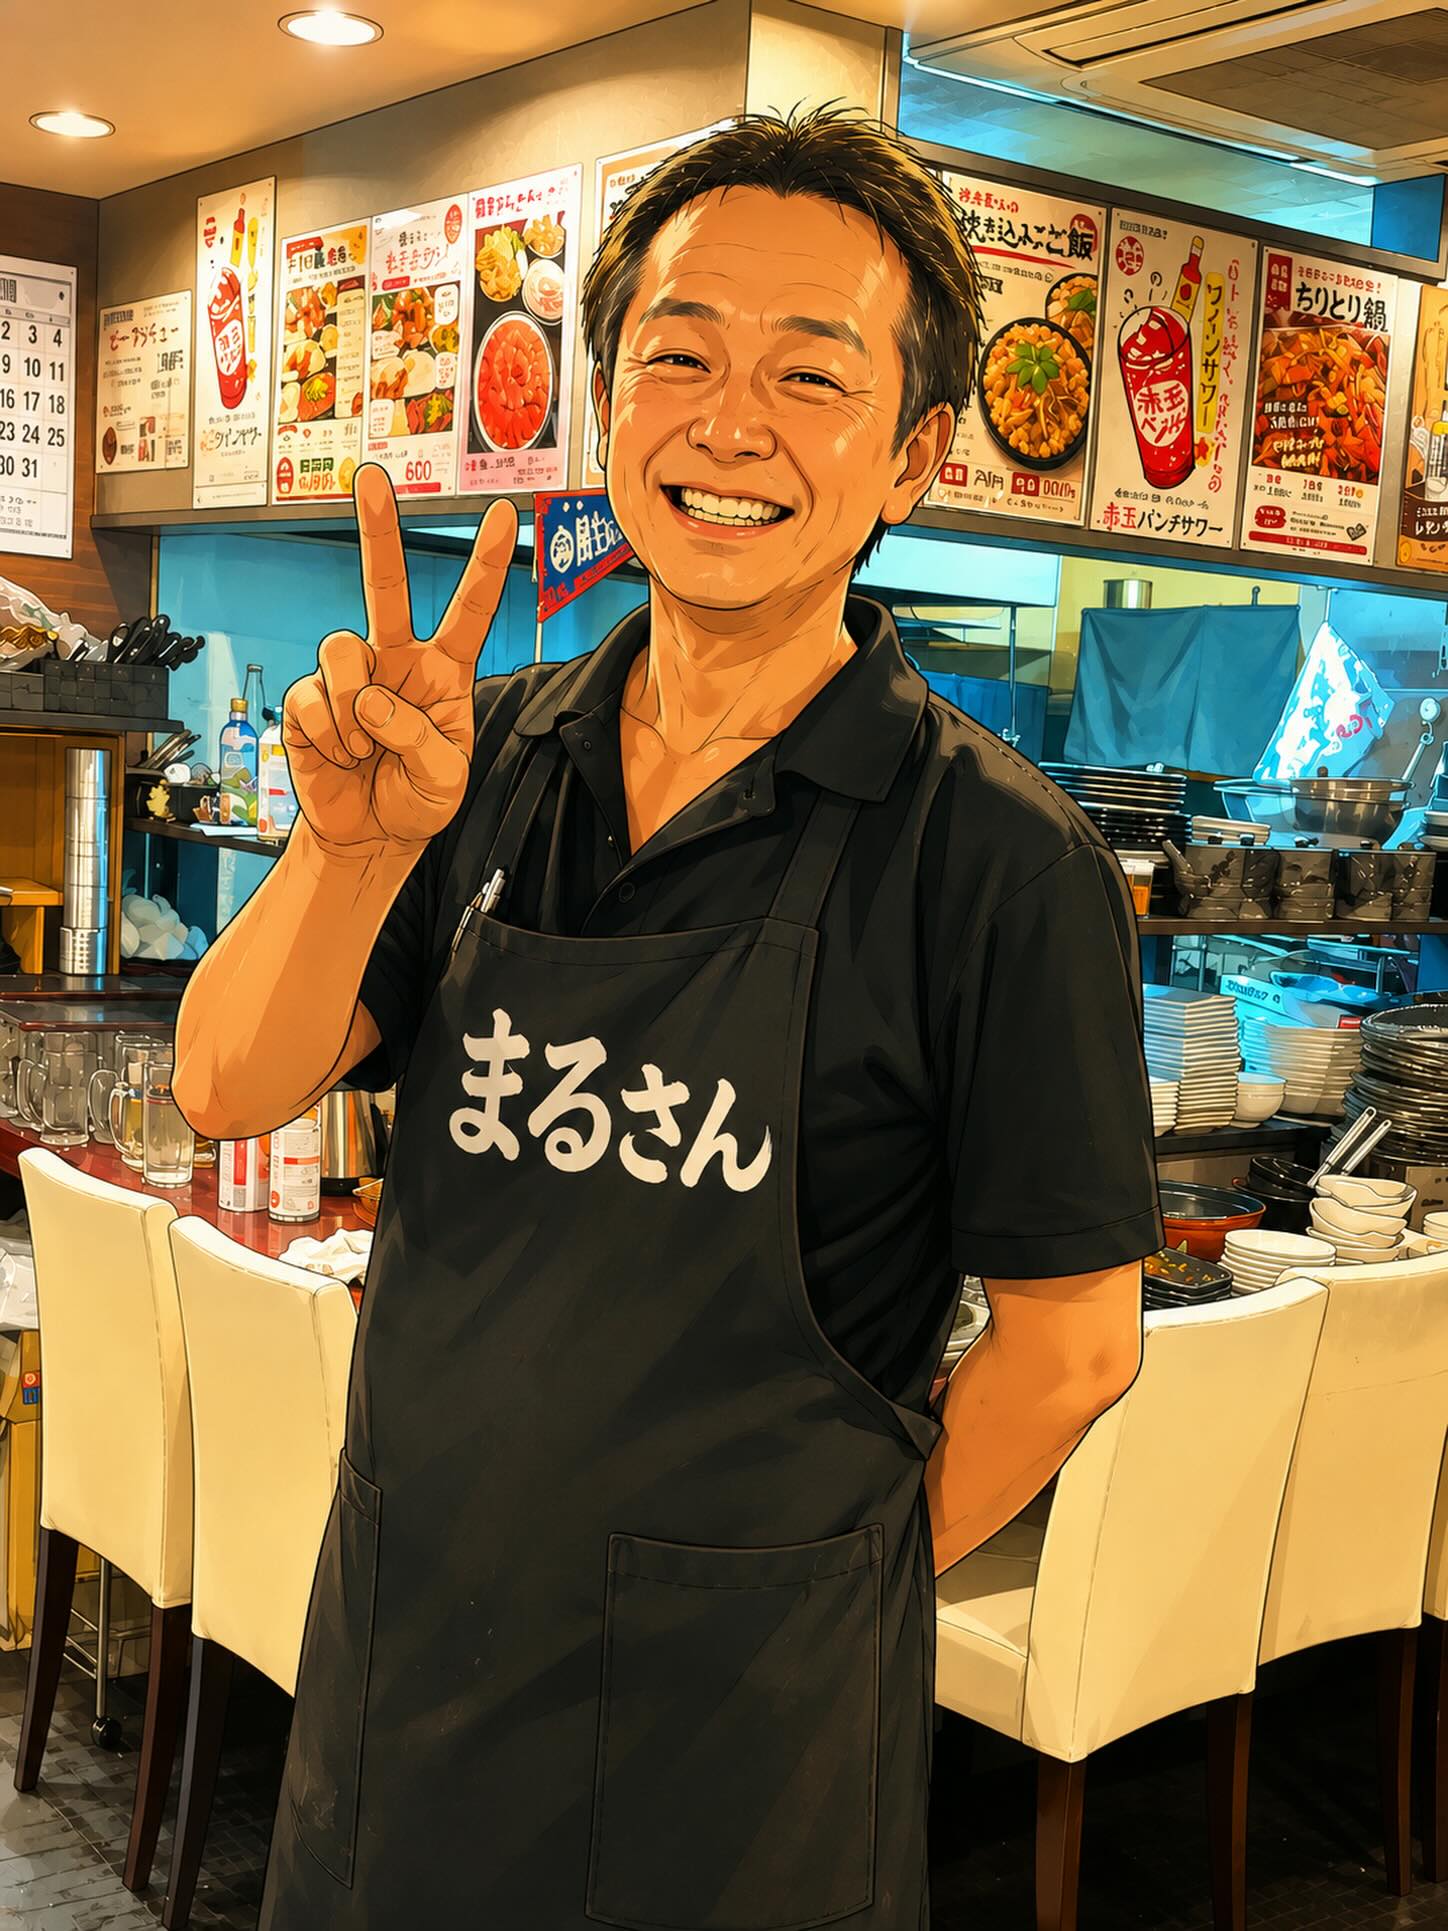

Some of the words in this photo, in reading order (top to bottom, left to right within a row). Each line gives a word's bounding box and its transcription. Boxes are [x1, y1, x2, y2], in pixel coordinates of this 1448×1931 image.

[1295, 280, 1389, 333] ちりとり鍋
[1, 320, 11, 341] 2
[28, 324, 38, 345] 3
[52, 328, 63, 348] 4
[1, 353, 11, 374] 9
[24, 356, 41, 378] 10
[49, 361, 65, 382] 11
[1200, 283, 1223, 427] ワインサワー
[0, 388, 15, 409] 16
[23, 390, 41, 411] 17
[48, 394, 65, 415] 18
[0, 420, 15, 441] 23
[22, 424, 40, 444] 24
[47, 427, 65, 447] 25
[22, 457, 37, 478] 31
[405, 460, 432, 481] 600
[1103, 500, 1224, 538] 赤玉パンチサワー
[448, 1007, 773, 1193] まるさん
